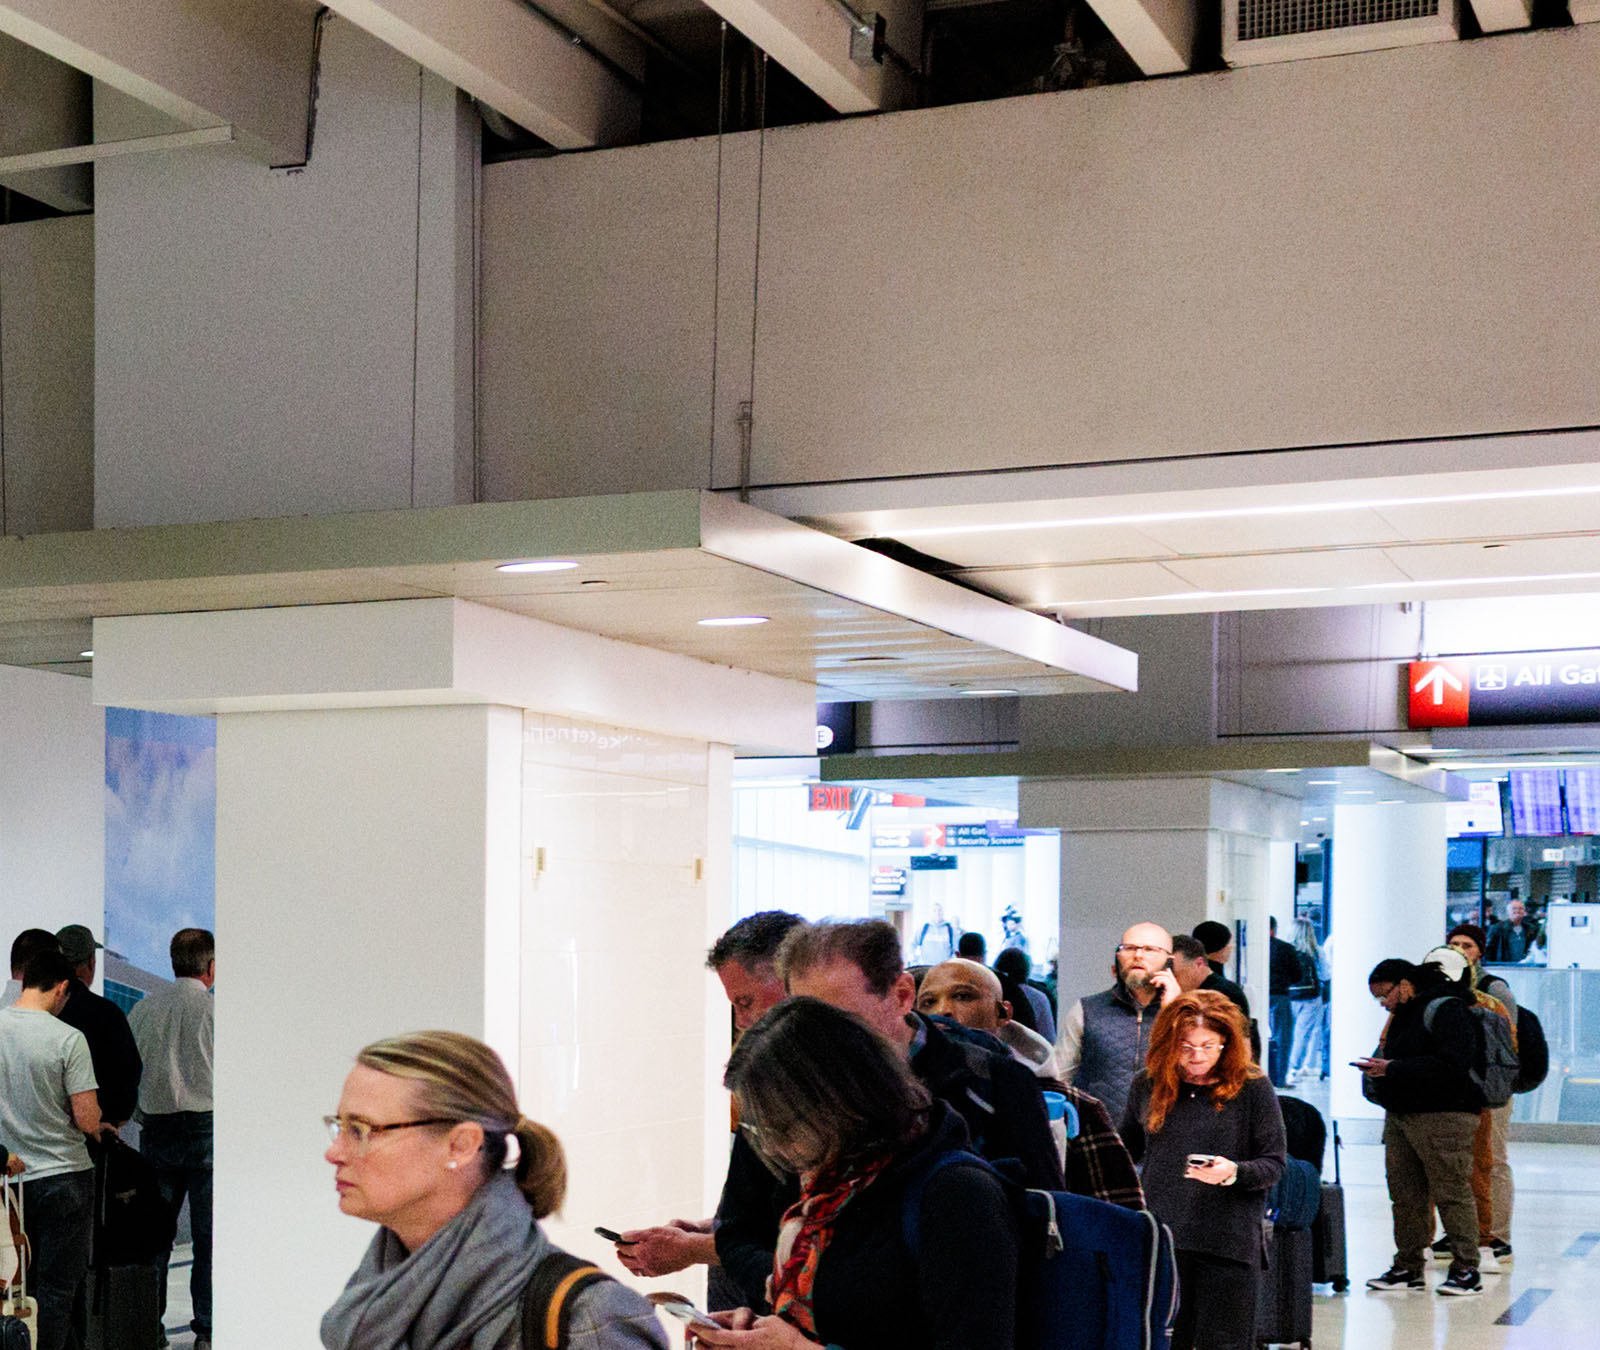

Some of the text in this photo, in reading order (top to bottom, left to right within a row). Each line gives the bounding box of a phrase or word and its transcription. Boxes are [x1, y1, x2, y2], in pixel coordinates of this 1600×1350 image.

[1514, 663, 1600, 686] All Ga
[817, 730, 825, 743] E
[813, 787, 853, 811] EXIT
[957, 837, 990, 847] Security
